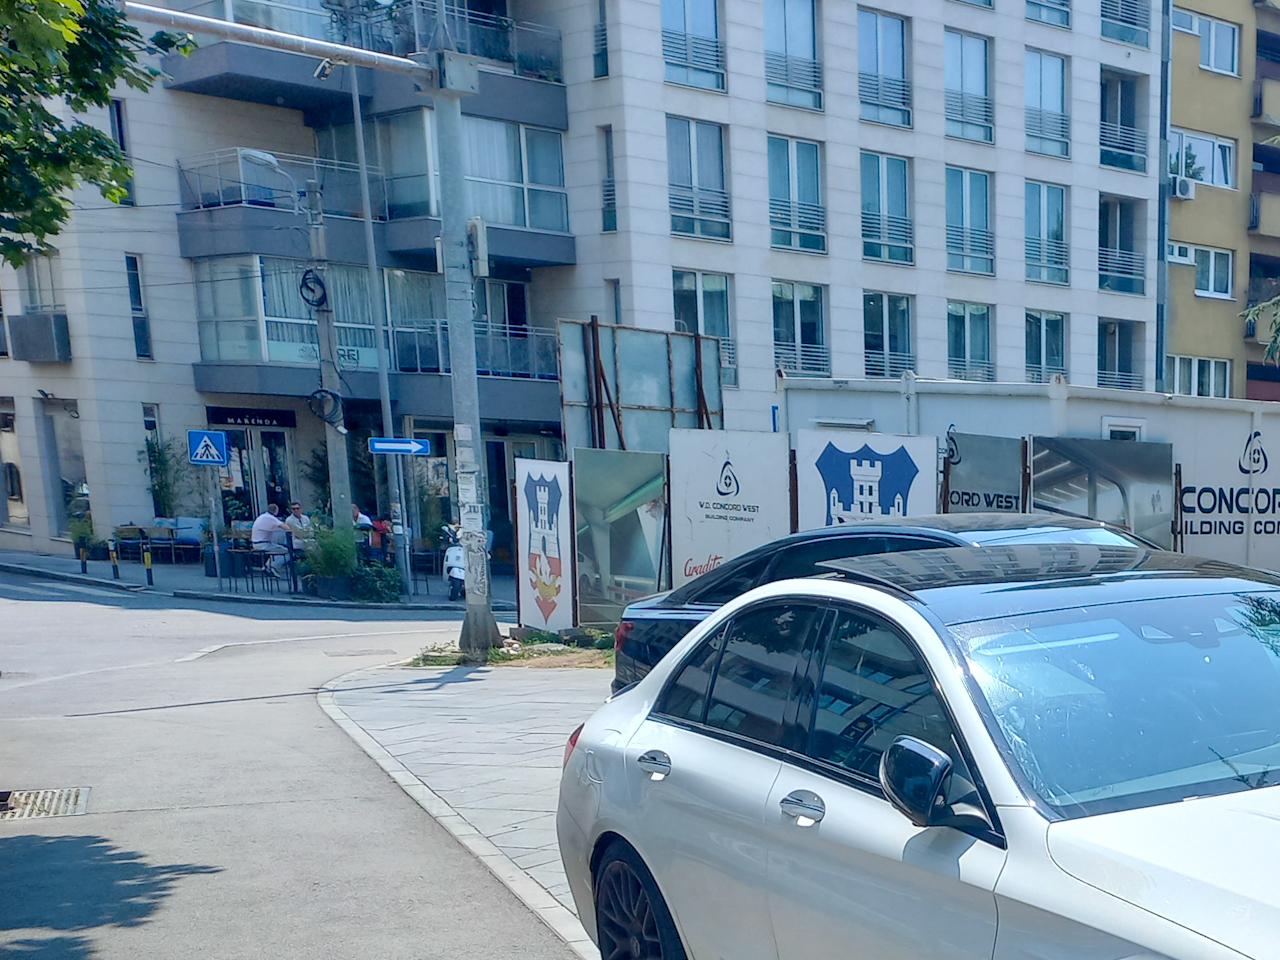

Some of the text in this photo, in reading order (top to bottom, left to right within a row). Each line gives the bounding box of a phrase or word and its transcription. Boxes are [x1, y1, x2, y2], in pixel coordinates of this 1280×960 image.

[950, 490, 1020, 510] ORD WEST
[712, 502, 742, 512] CONCORD
[742, 504, 760, 513] WEST
[729, 515, 755, 523] COMPANY
[1171, 520, 1244, 535] UILDING
